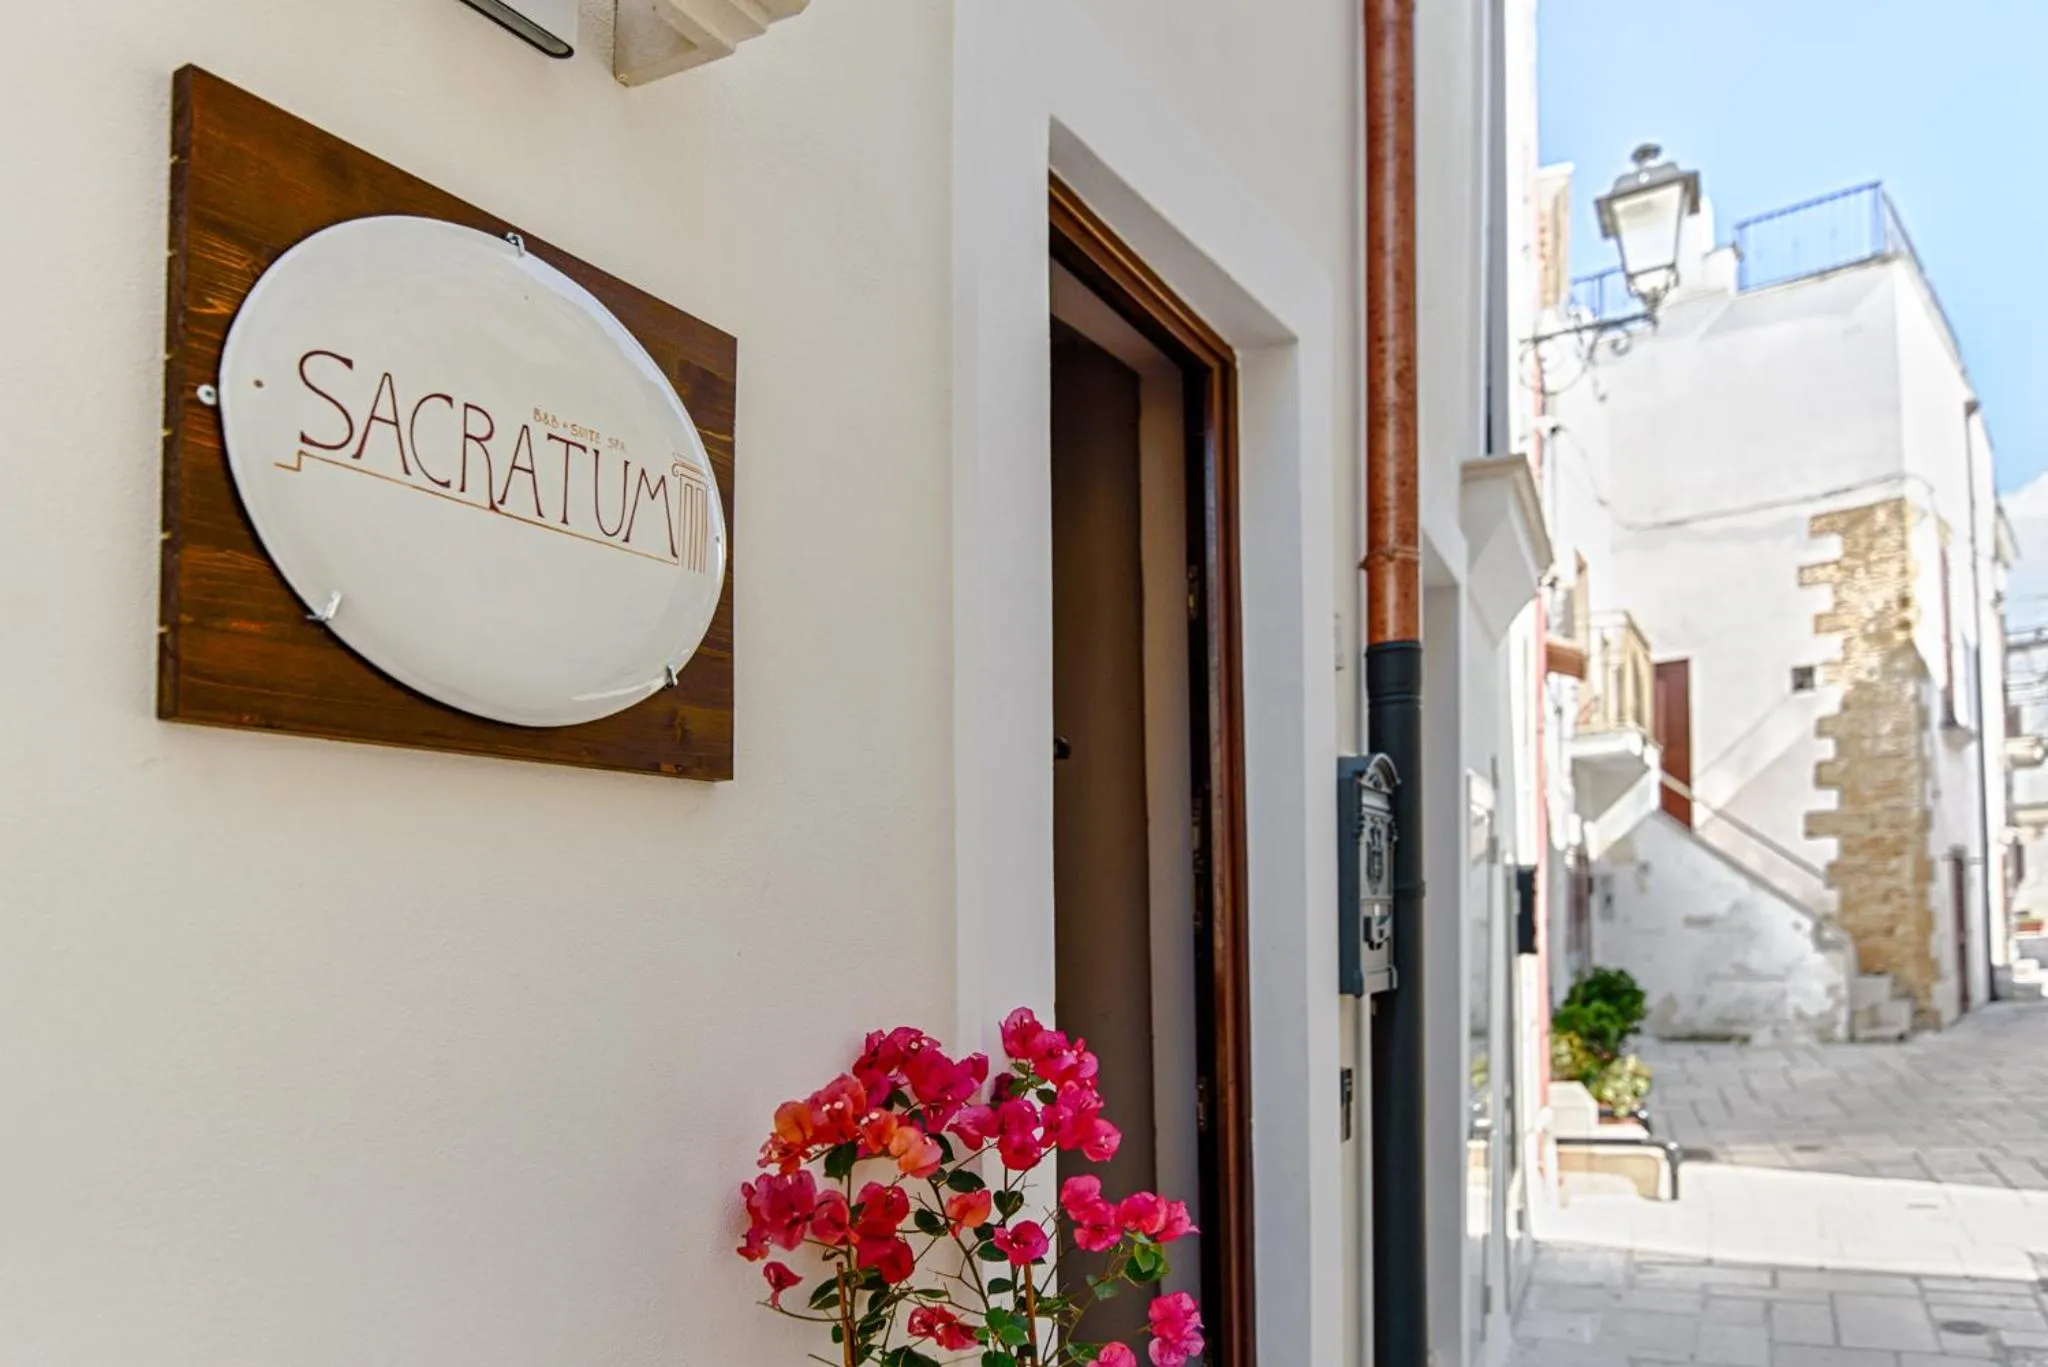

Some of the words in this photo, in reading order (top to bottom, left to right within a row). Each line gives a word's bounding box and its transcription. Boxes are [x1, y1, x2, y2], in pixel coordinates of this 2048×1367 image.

[299, 350, 678, 558] SACRATUM
[533, 406, 559, 428] B&B
[570, 423, 600, 444] SUITE
[606, 436, 626, 452] SPA
